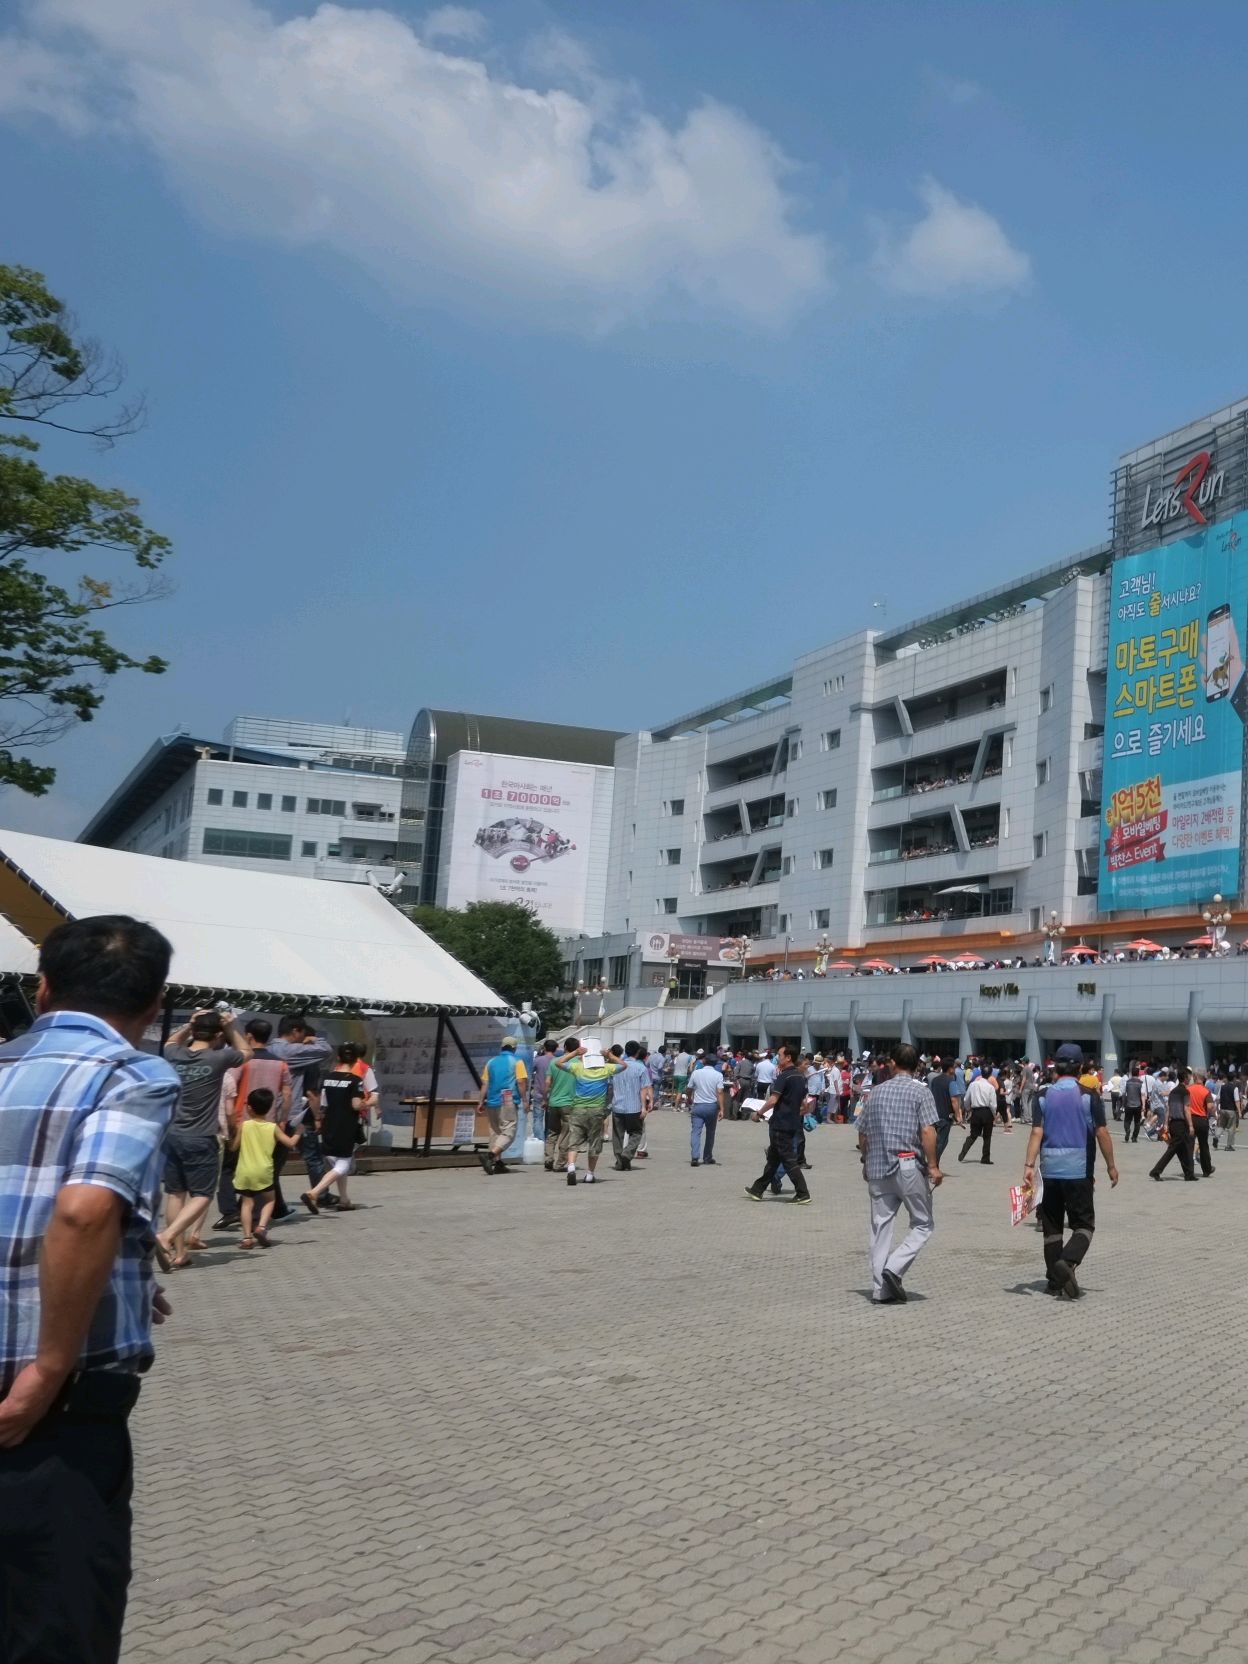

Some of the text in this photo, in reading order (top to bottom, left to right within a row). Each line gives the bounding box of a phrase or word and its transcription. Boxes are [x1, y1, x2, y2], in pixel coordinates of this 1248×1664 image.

[1119, 572, 1156, 598] 고객님!
[1117, 601, 1146, 621] 아직도
[1115, 619, 1199, 676] 마토구매
[1113, 664, 1198, 718] 스마트폰
[1112, 714, 1206, 759] 으로 즐기세요
